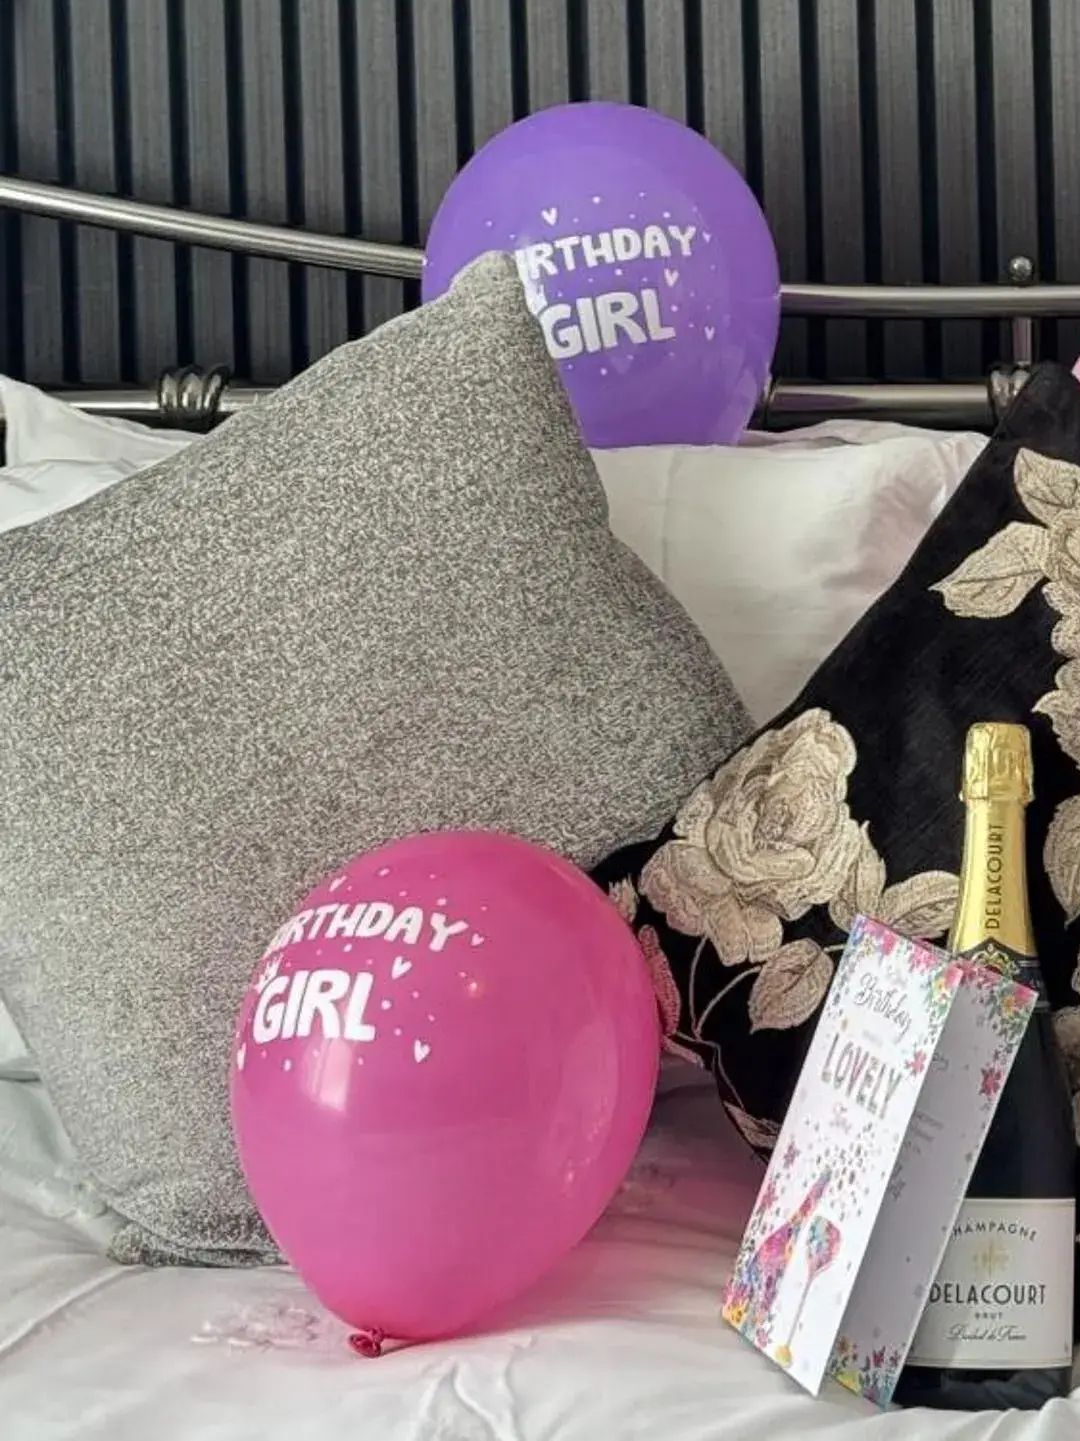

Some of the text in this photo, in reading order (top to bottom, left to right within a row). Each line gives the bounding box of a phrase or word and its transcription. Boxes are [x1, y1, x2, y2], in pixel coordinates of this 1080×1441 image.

[514, 224, 696, 280] IRTHDAY
[540, 289, 676, 360] GIRL
[985, 823, 1004, 930] DELACOURT
[253, 969, 376, 1045] GIRL
[821, 1033, 902, 1120] LOVELY
[951, 1220, 1037, 1242] HAMPAGNE
[929, 1283, 1046, 1306] DELACOURT
